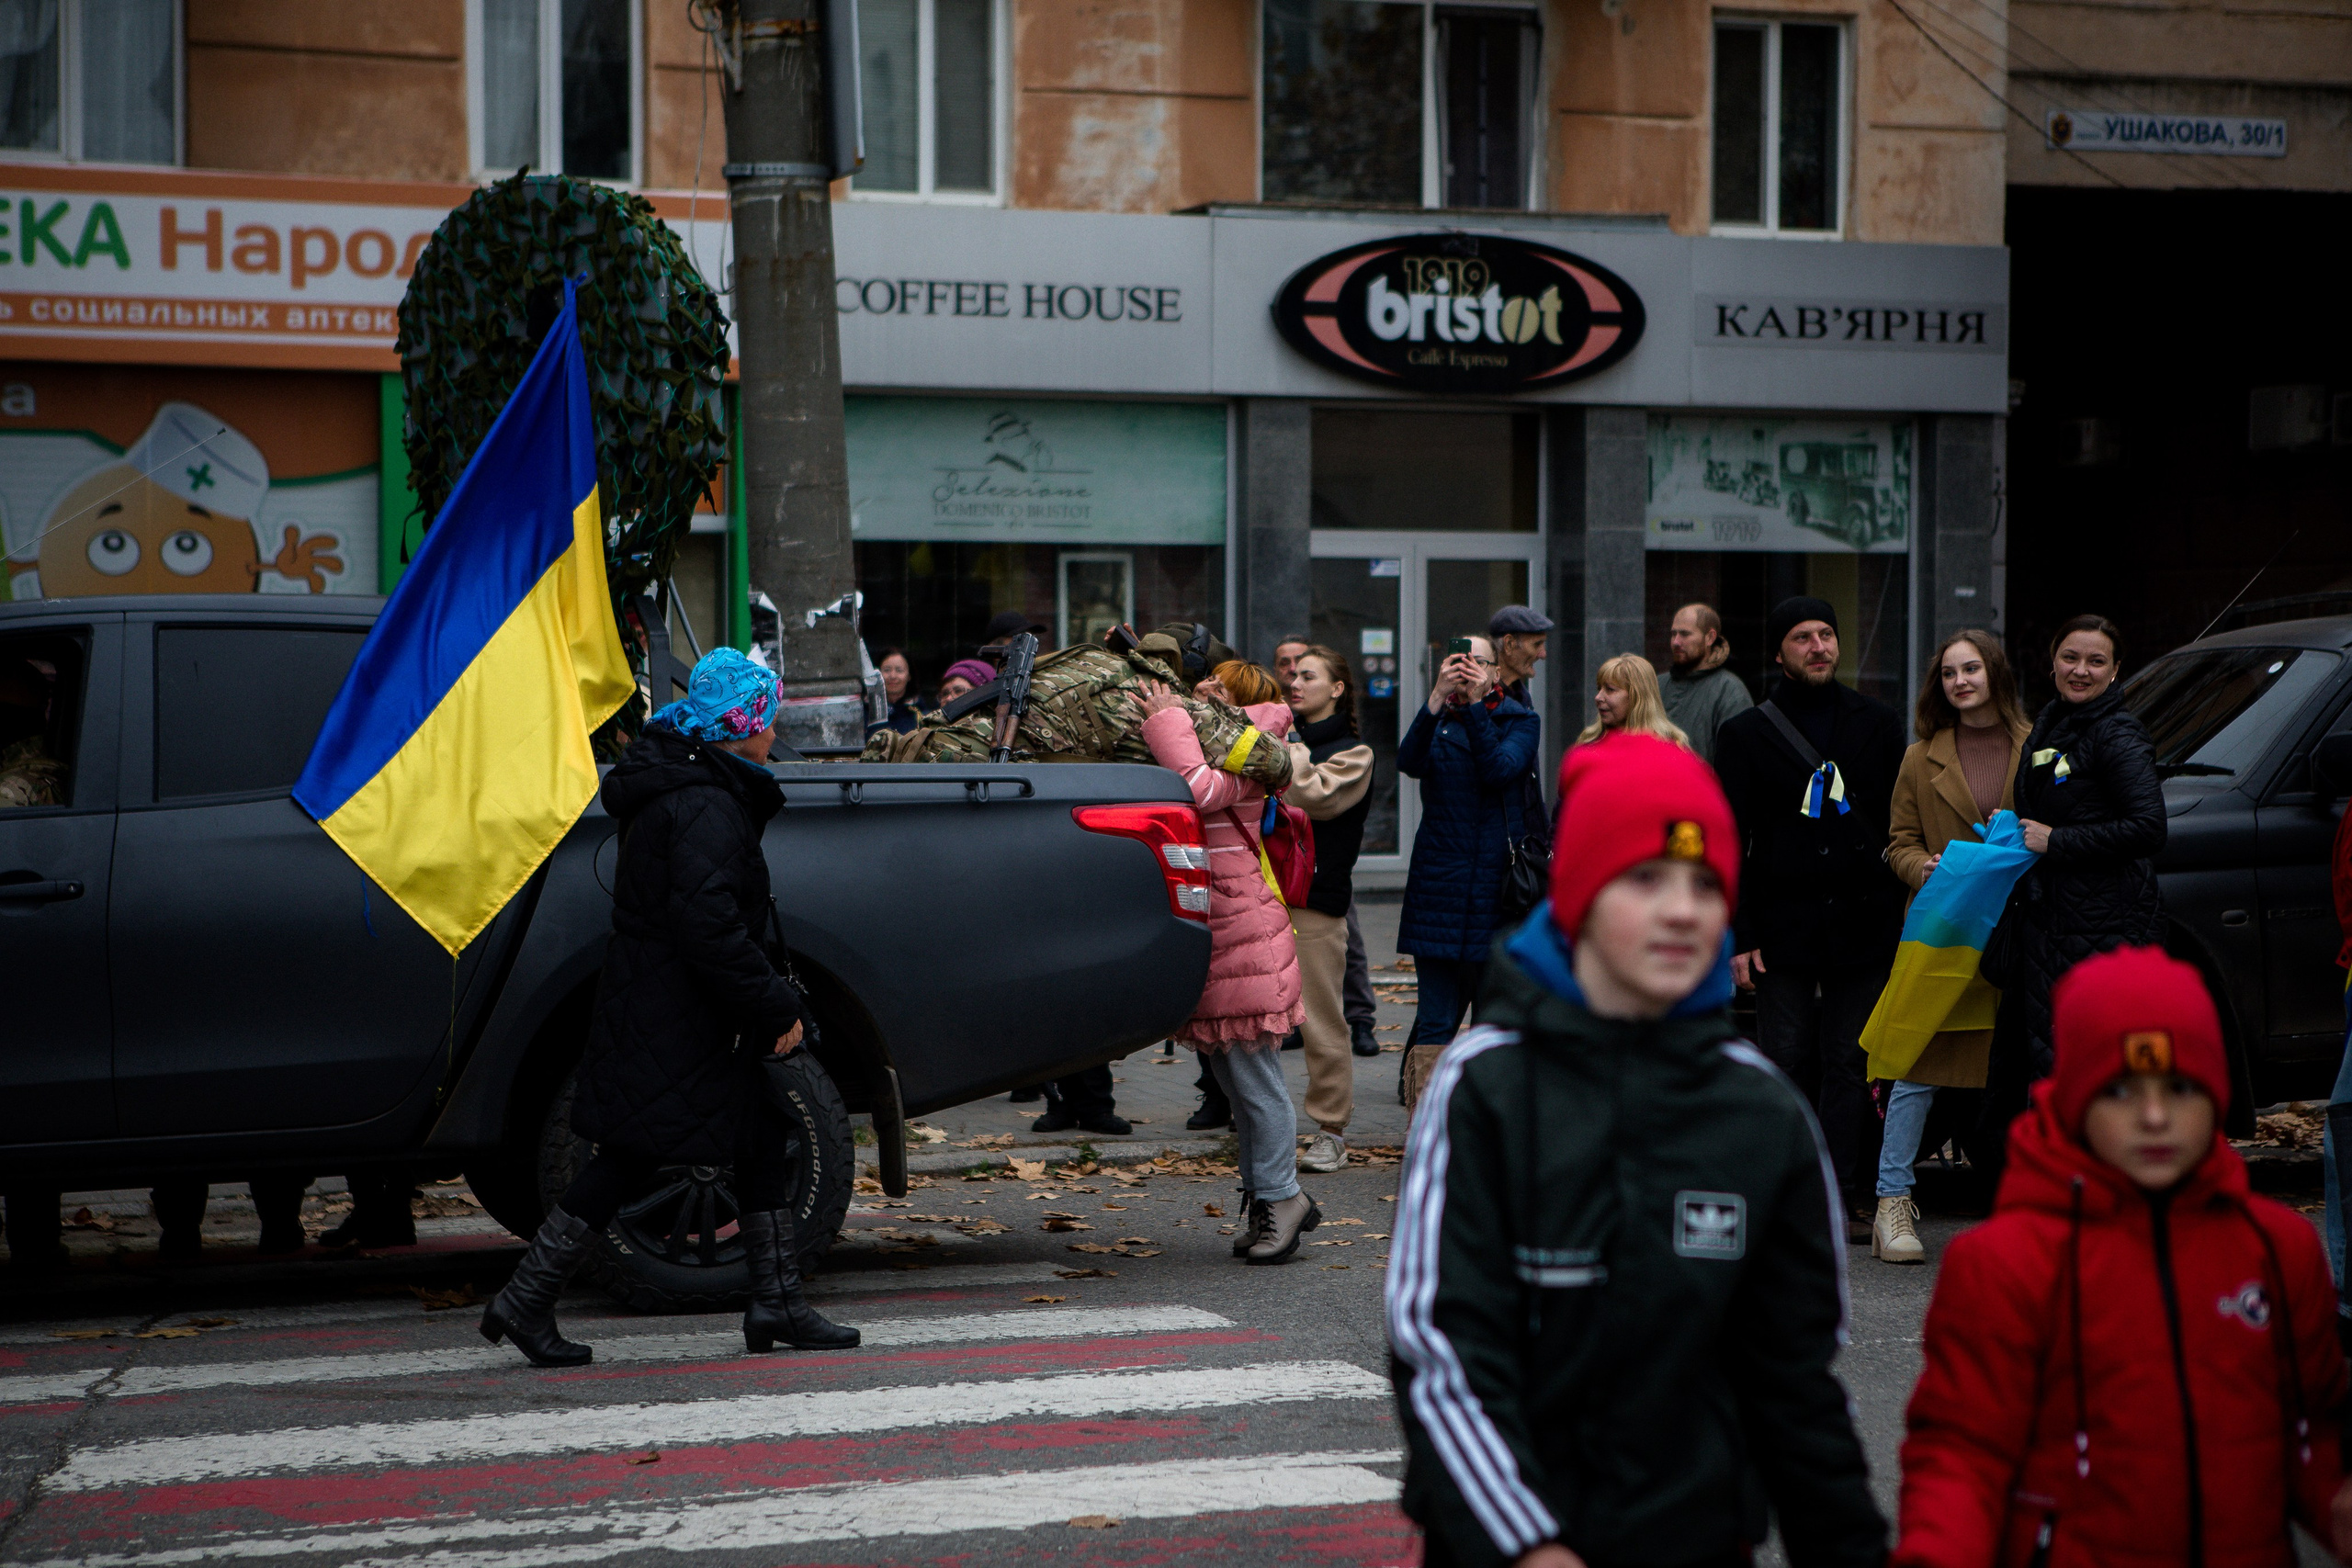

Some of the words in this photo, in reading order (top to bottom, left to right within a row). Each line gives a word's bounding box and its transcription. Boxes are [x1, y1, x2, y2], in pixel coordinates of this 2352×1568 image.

[2104, 118, 2234, 147] УШАКОВА,
[2241, 122, 2285, 147] 30/1
[1403, 257, 1489, 297] 1919
[29, 299, 269, 328] социальных
[286, 306, 394, 332] аптек
[834, 277, 1011, 318] COFFEE
[1022, 284, 1182, 322] HOUSE
[1366, 274, 1563, 345] bristot
[933, 471, 1092, 502] Selezione
[1027, 505, 1091, 519] BRISTOT
[787, 1090, 822, 1220] BFGoodrich
